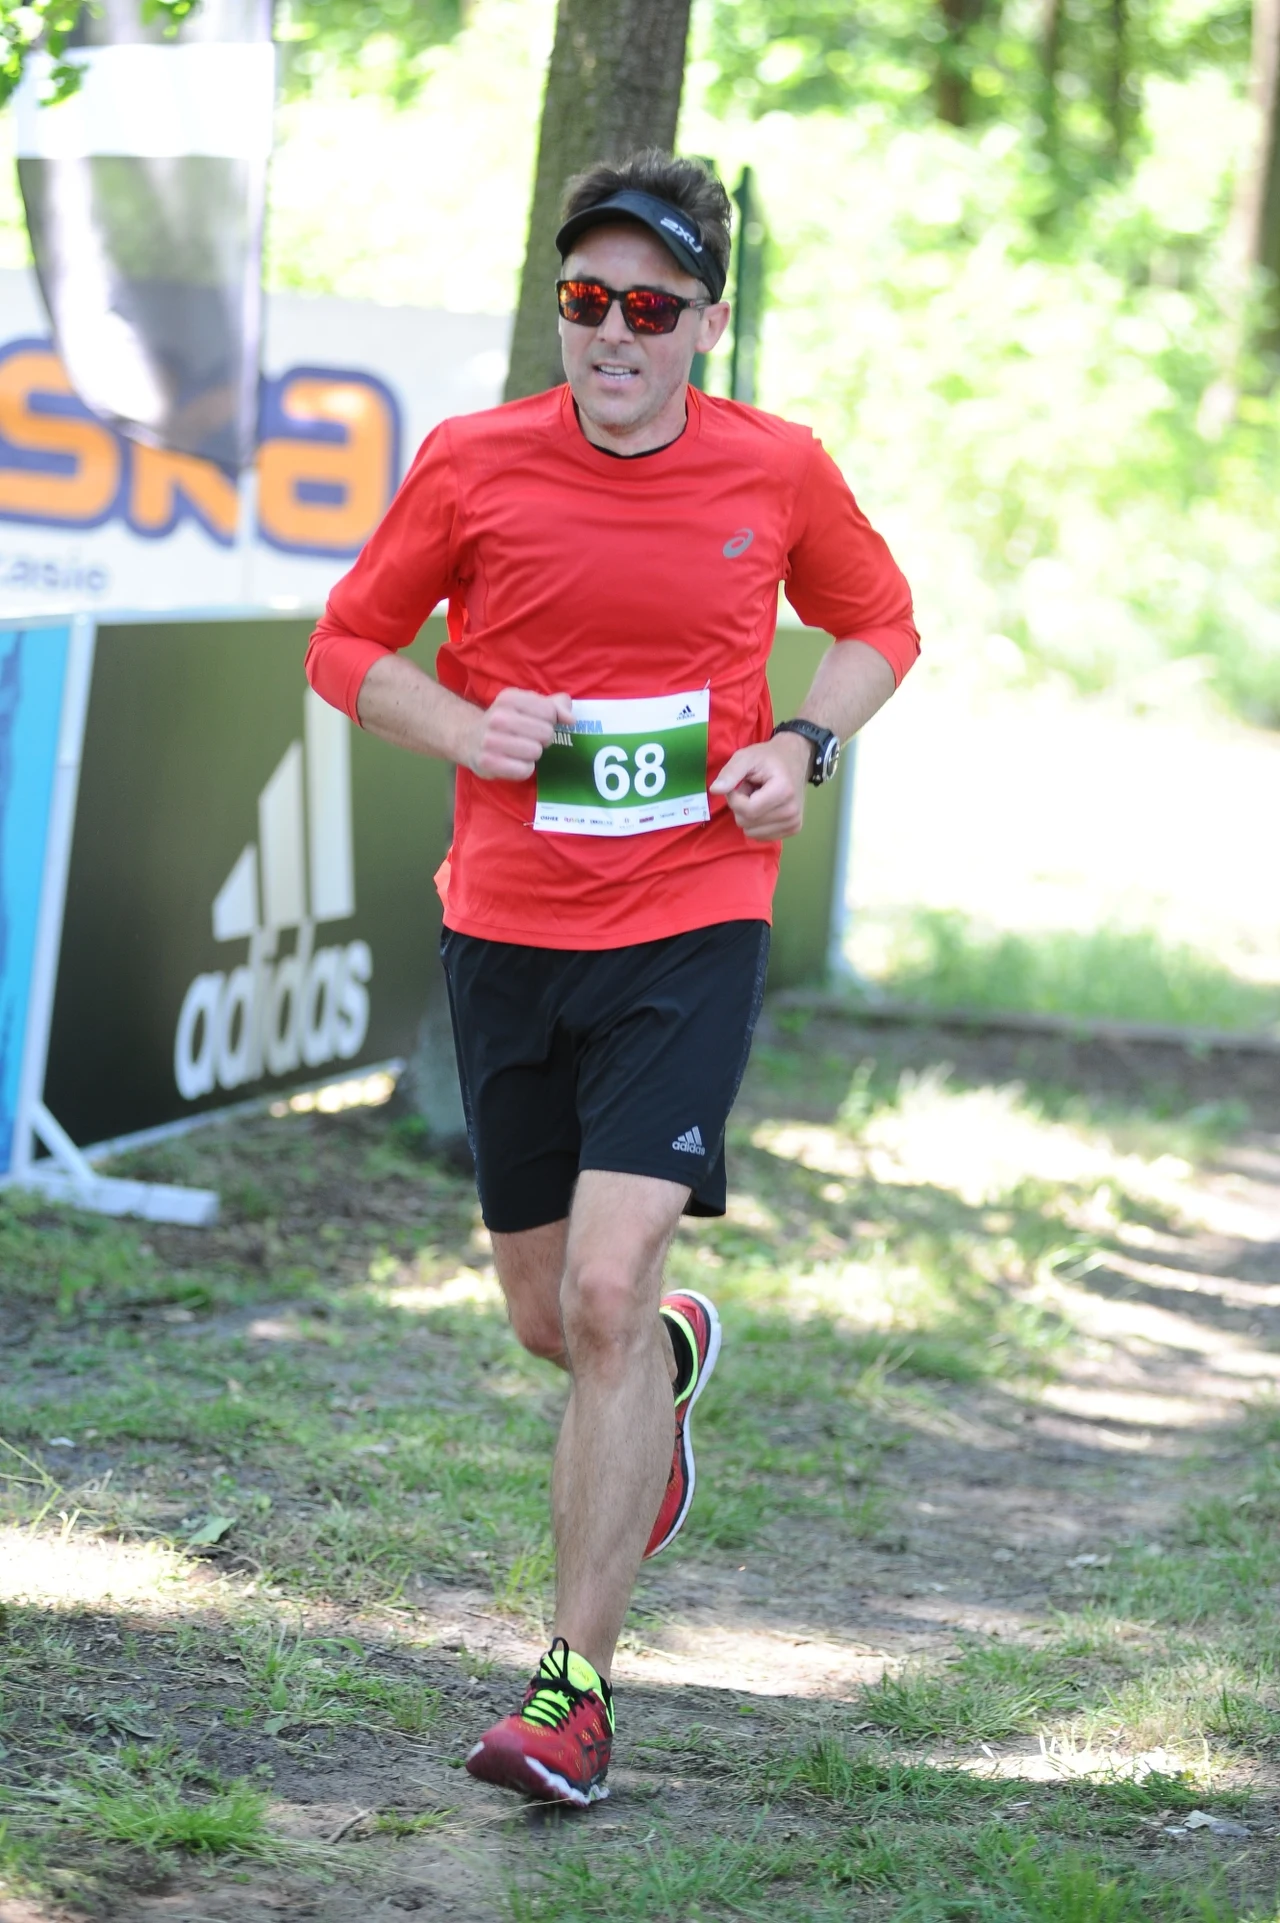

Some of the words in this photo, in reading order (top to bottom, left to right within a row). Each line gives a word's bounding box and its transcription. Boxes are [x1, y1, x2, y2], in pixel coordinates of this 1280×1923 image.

[660, 217, 702, 253] 2XU
[593, 742, 666, 801] 68
[174, 917, 374, 1101] adidas
[671, 1140, 706, 1157] adidas
